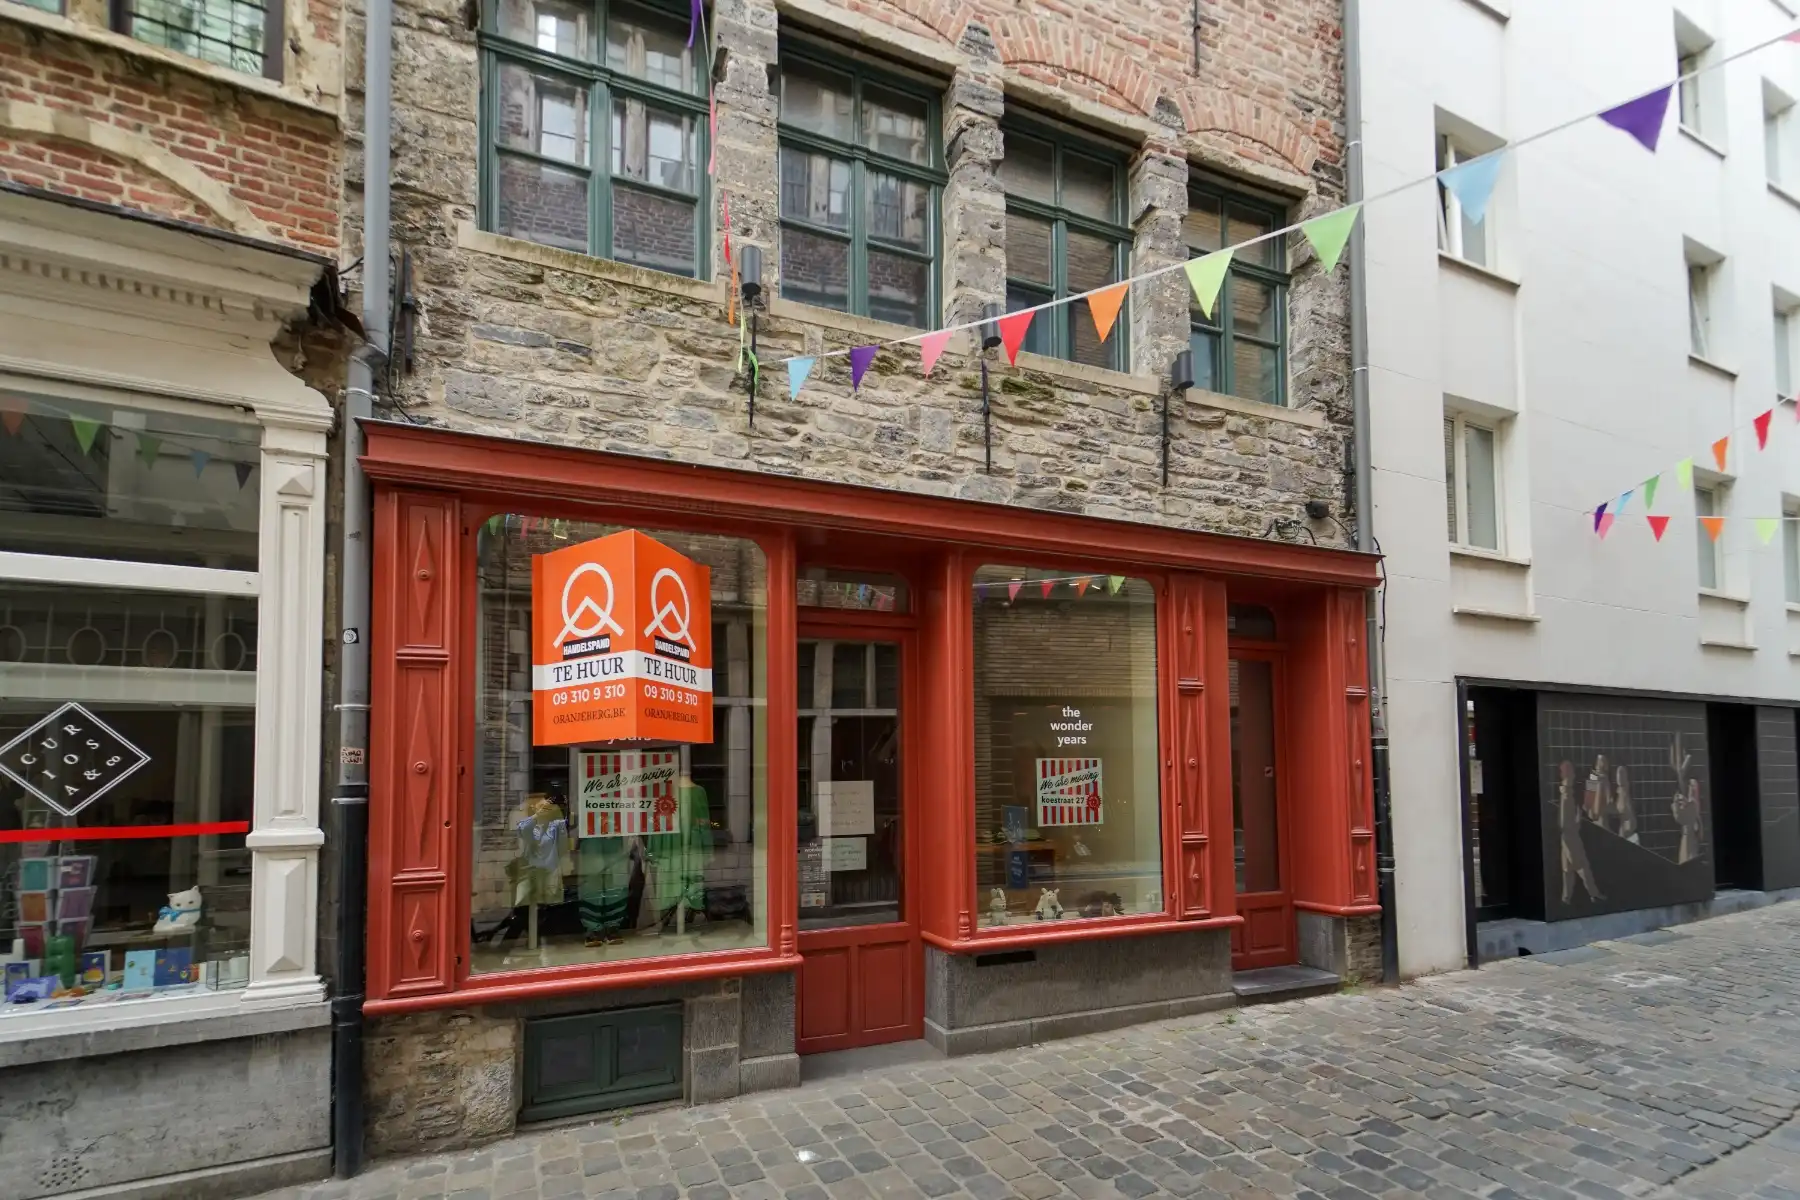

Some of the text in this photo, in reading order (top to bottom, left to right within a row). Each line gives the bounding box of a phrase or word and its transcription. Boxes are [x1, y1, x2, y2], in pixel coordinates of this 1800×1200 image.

[563, 638, 610, 655] HANDELSPAND
[553, 656, 624, 682] TE HUUR
[644, 656, 697, 685] TE HUUR
[552, 684, 625, 705] 09 310 9 310
[644, 684, 698, 706] 09 310 9 310
[553, 707, 626, 724] ORANJEBERG.BE
[1062, 706, 1081, 717] the
[1050, 720, 1093, 731] wonder
[1057, 735, 1087, 747] years
[584, 768, 675, 793] We are moving
[1040, 771, 1099, 791] We are moving
[585, 800, 652, 809] koestraat 27
[1041, 796, 1074, 804] koestraat
